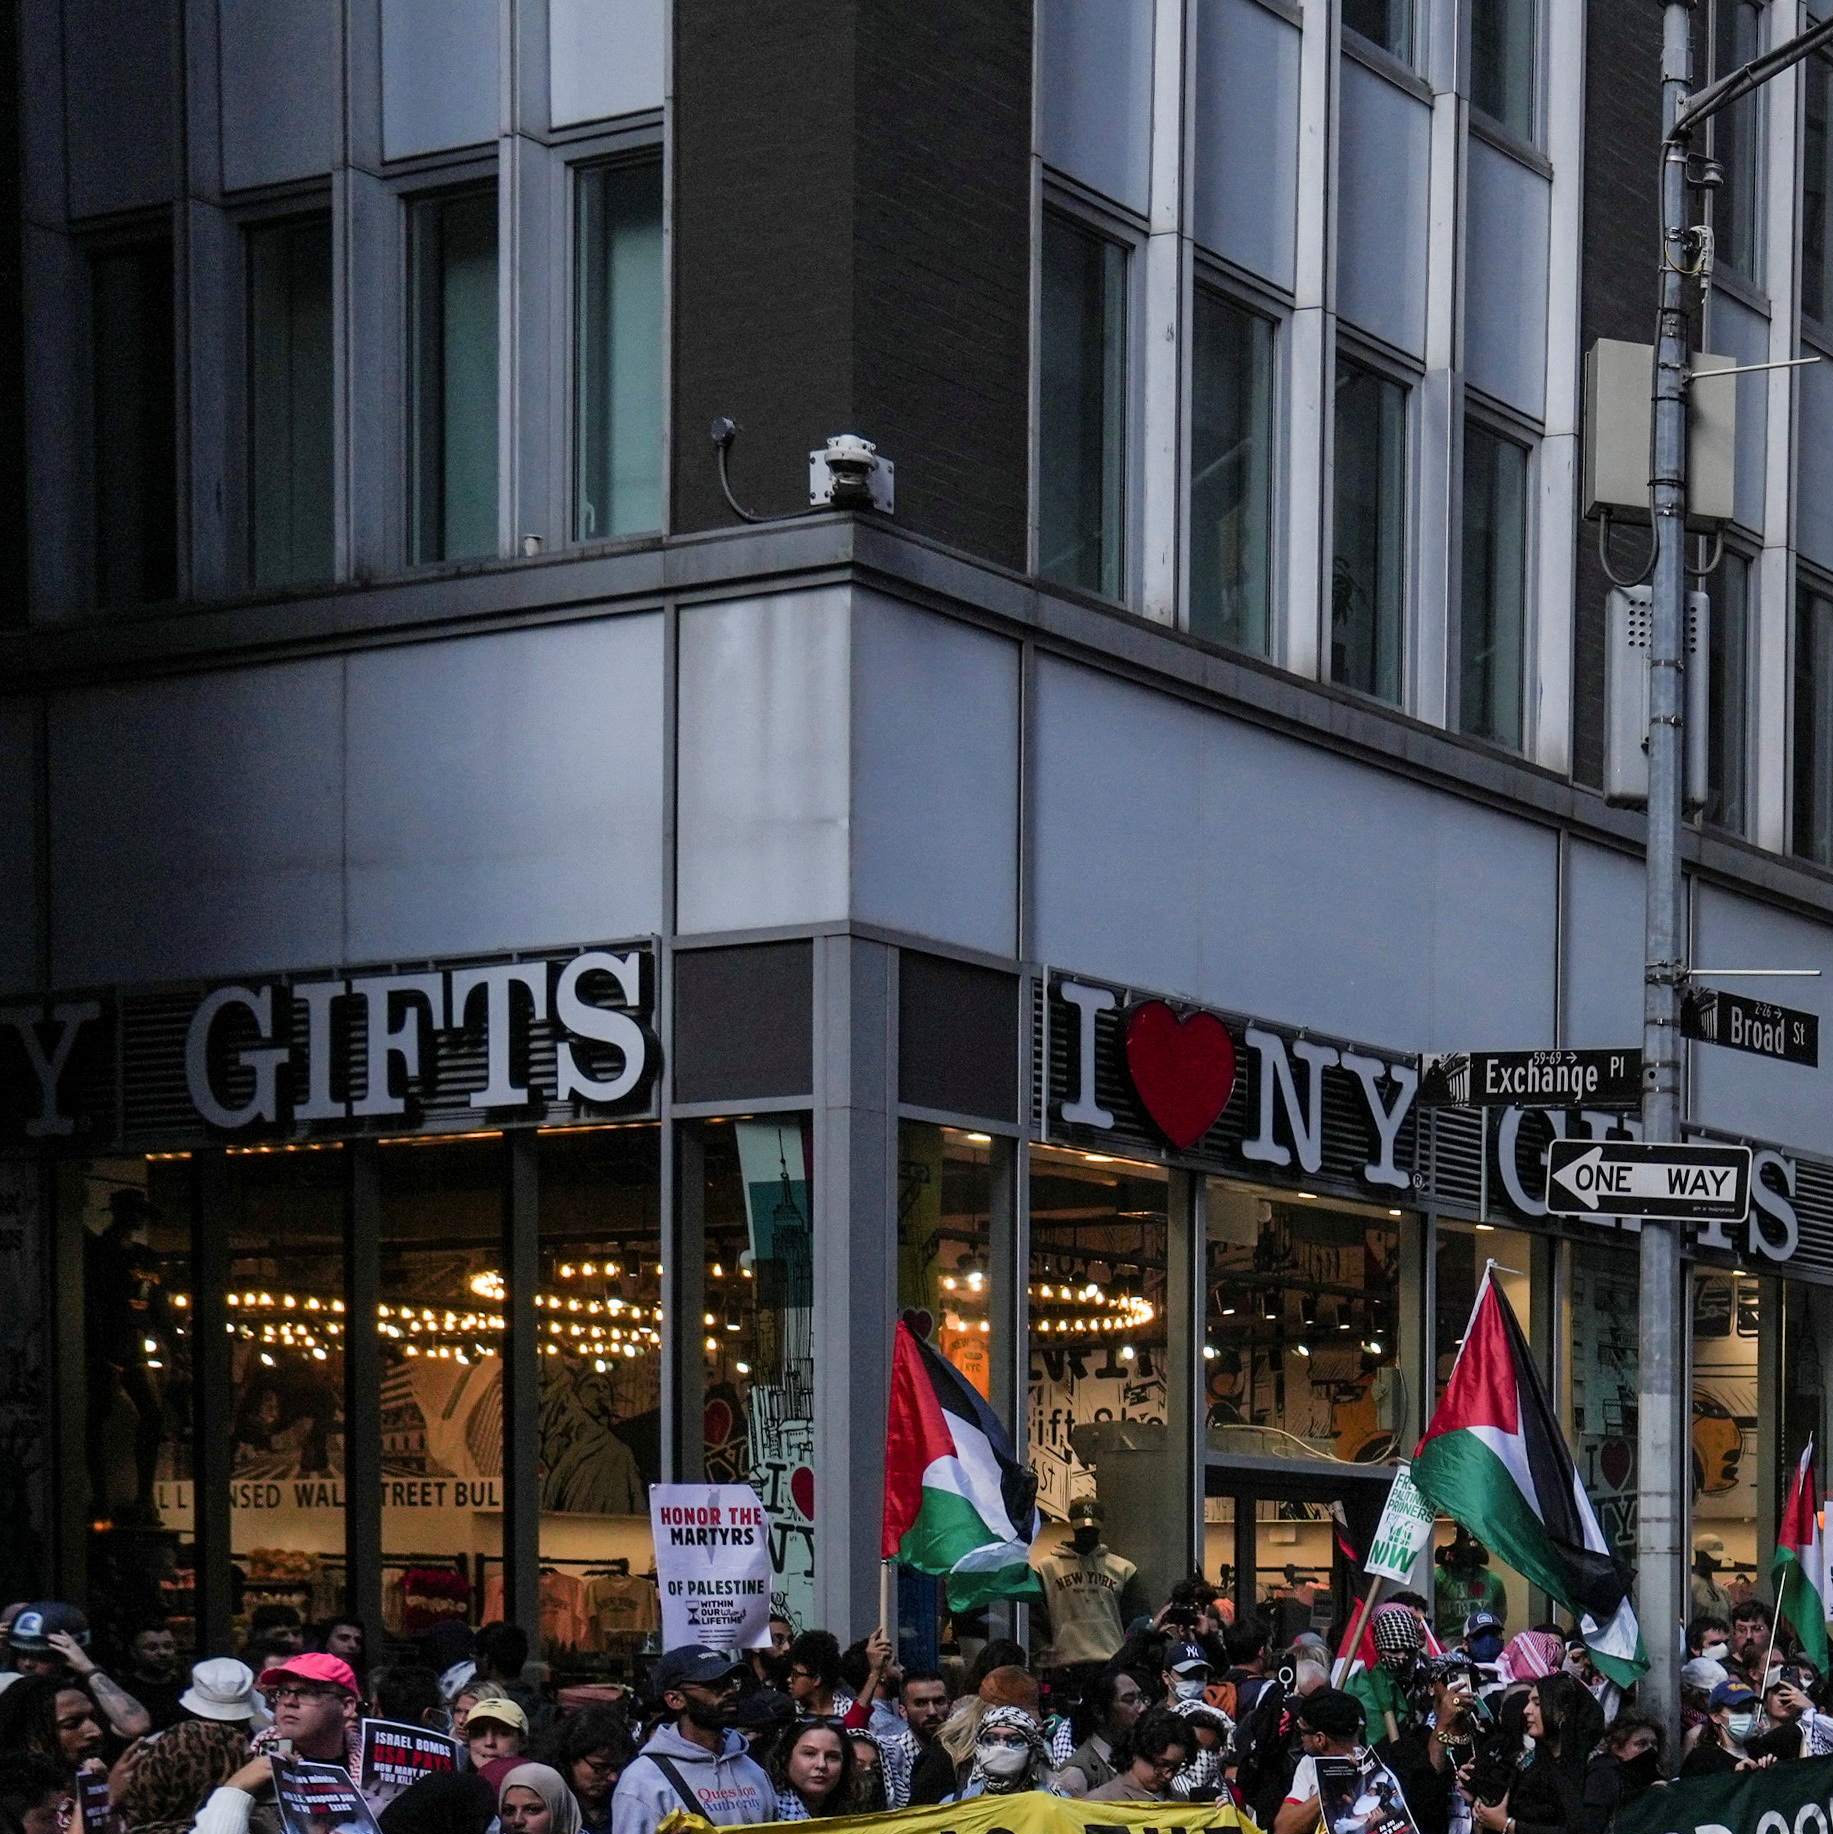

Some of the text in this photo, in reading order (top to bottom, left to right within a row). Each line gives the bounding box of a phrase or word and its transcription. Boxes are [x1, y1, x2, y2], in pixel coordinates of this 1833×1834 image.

[1755, 1002, 1772, 1018] 2-26
[185, 950, 646, 1130] GIFTS
[1731, 1006, 1806, 1055] Broad St
[1534, 1051, 1562, 1065] 59-69
[1059, 982, 1116, 1130] I
[1241, 1027, 1418, 1191] NY
[1485, 1057, 1625, 1100] Exchange Pl
[1575, 1164, 1732, 1197] ONE WAY
[661, 1507, 762, 1526] HONOR THE
[670, 1527, 754, 1546] MARTYRS
[668, 1579, 764, 1596] OF PALESTINE
[1055, 1572, 1083, 1591] NEW
[700, 1600, 734, 1608] WITHIN
[701, 1608, 720, 1616] OUR
[702, 1617, 742, 1625] LIFETIME
[375, 1731, 451, 1757] ISRAEL BOMBS
[374, 1746, 406, 1765] USA
[397, 1775, 413, 1785] KILL
